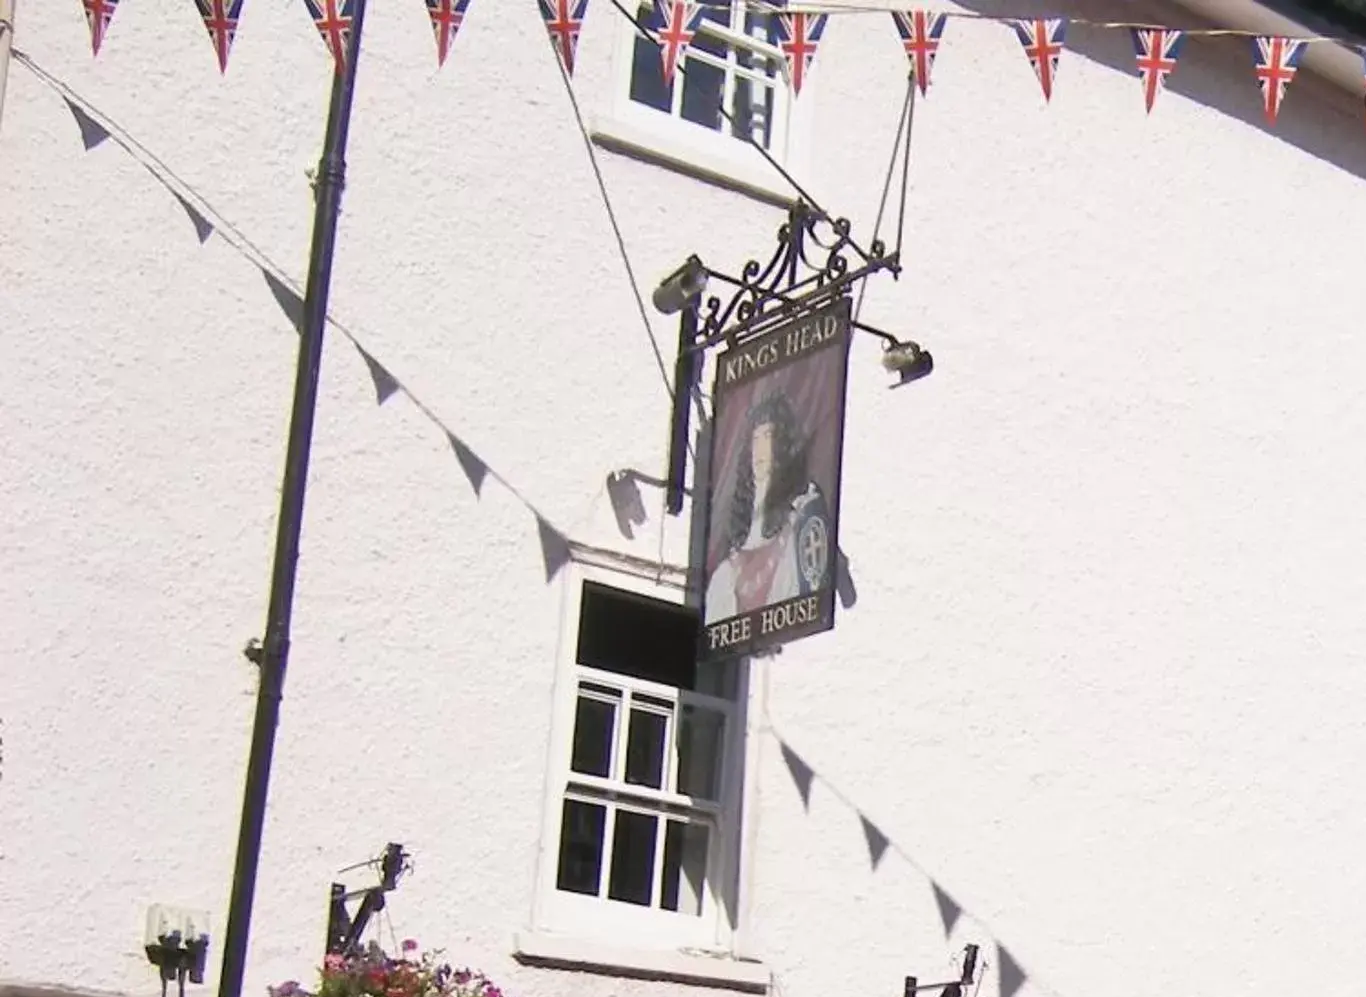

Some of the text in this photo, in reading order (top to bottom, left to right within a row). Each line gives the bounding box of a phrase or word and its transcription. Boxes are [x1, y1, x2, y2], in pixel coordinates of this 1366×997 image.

[725, 314, 838, 383] KINGS HEAD
[709, 597, 819, 650] FREE HOUSE
